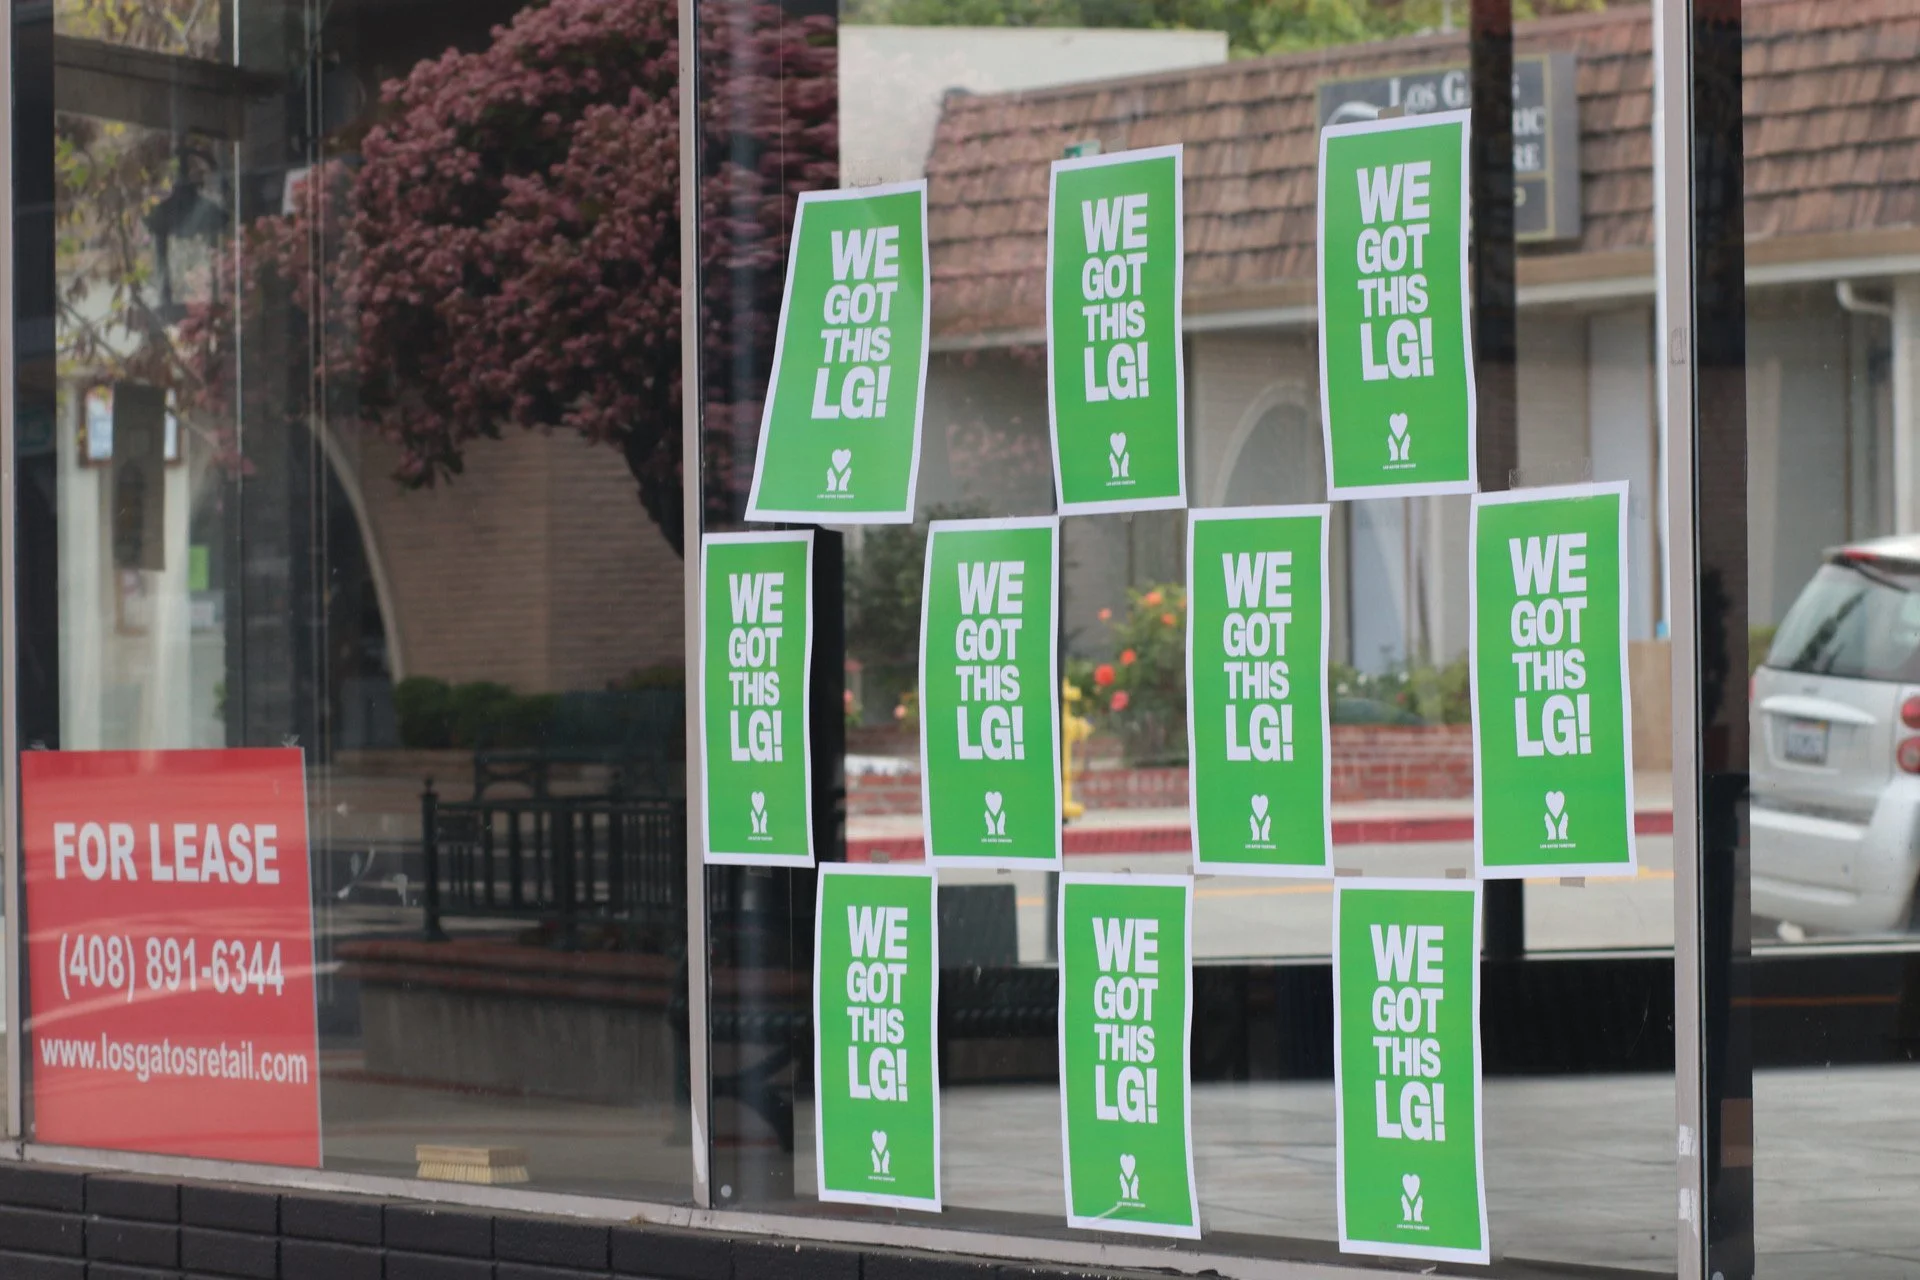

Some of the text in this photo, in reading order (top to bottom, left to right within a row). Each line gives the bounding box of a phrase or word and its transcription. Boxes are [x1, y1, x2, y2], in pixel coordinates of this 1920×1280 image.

[1357, 161, 1431, 224] WE
[1082, 193, 1148, 253] WE
[1357, 223, 1429, 274] GOT
[831, 226, 899, 280] WE
[1082, 252, 1147, 300] GOT
[824, 281, 898, 324] GOT
[1083, 300, 1145, 341] THIS
[1358, 274, 1428, 317] THIS
[821, 326, 891, 363] THIS
[1361, 317, 1434, 380] LG!
[811, 365, 891, 419] LG!
[1084, 342, 1149, 401] LG!
[958, 561, 1024, 615] WE
[1222, 551, 1292, 608] WE
[1509, 532, 1587, 596] WE
[729, 572, 784, 623] WE
[1511, 596, 1587, 647] GOT
[729, 627, 782, 667] GOT
[956, 618, 1022, 661] GOT
[1223, 612, 1292, 657] GOT
[729, 671, 780, 706] THIS
[956, 665, 1020, 701] THIS
[1224, 661, 1289, 699] THIS
[1512, 649, 1586, 691] THIS
[730, 710, 782, 762] LG!
[957, 705, 1024, 760] LG!
[1226, 704, 1293, 762] LG!
[1515, 694, 1591, 756] LG!
[54, 822, 279, 883] FOR LEASE
[847, 906, 908, 959] WE
[1092, 917, 1158, 973] WE
[1370, 924, 1444, 983] WE
[59, 933, 284, 1002] (408) 891-6344
[847, 961, 907, 1004] GOT
[1094, 976, 1158, 1021] GOT
[1372, 986, 1443, 1033] GOT
[847, 1007, 904, 1044] THIS
[1094, 1024, 1155, 1063] THIS
[41, 1033, 308, 1084] www.losgatosretail.com
[848, 1046, 908, 1101] LG!
[1373, 1036, 1441, 1078] THIS
[1096, 1065, 1157, 1124] LG!
[1375, 1080, 1445, 1141] LG!
